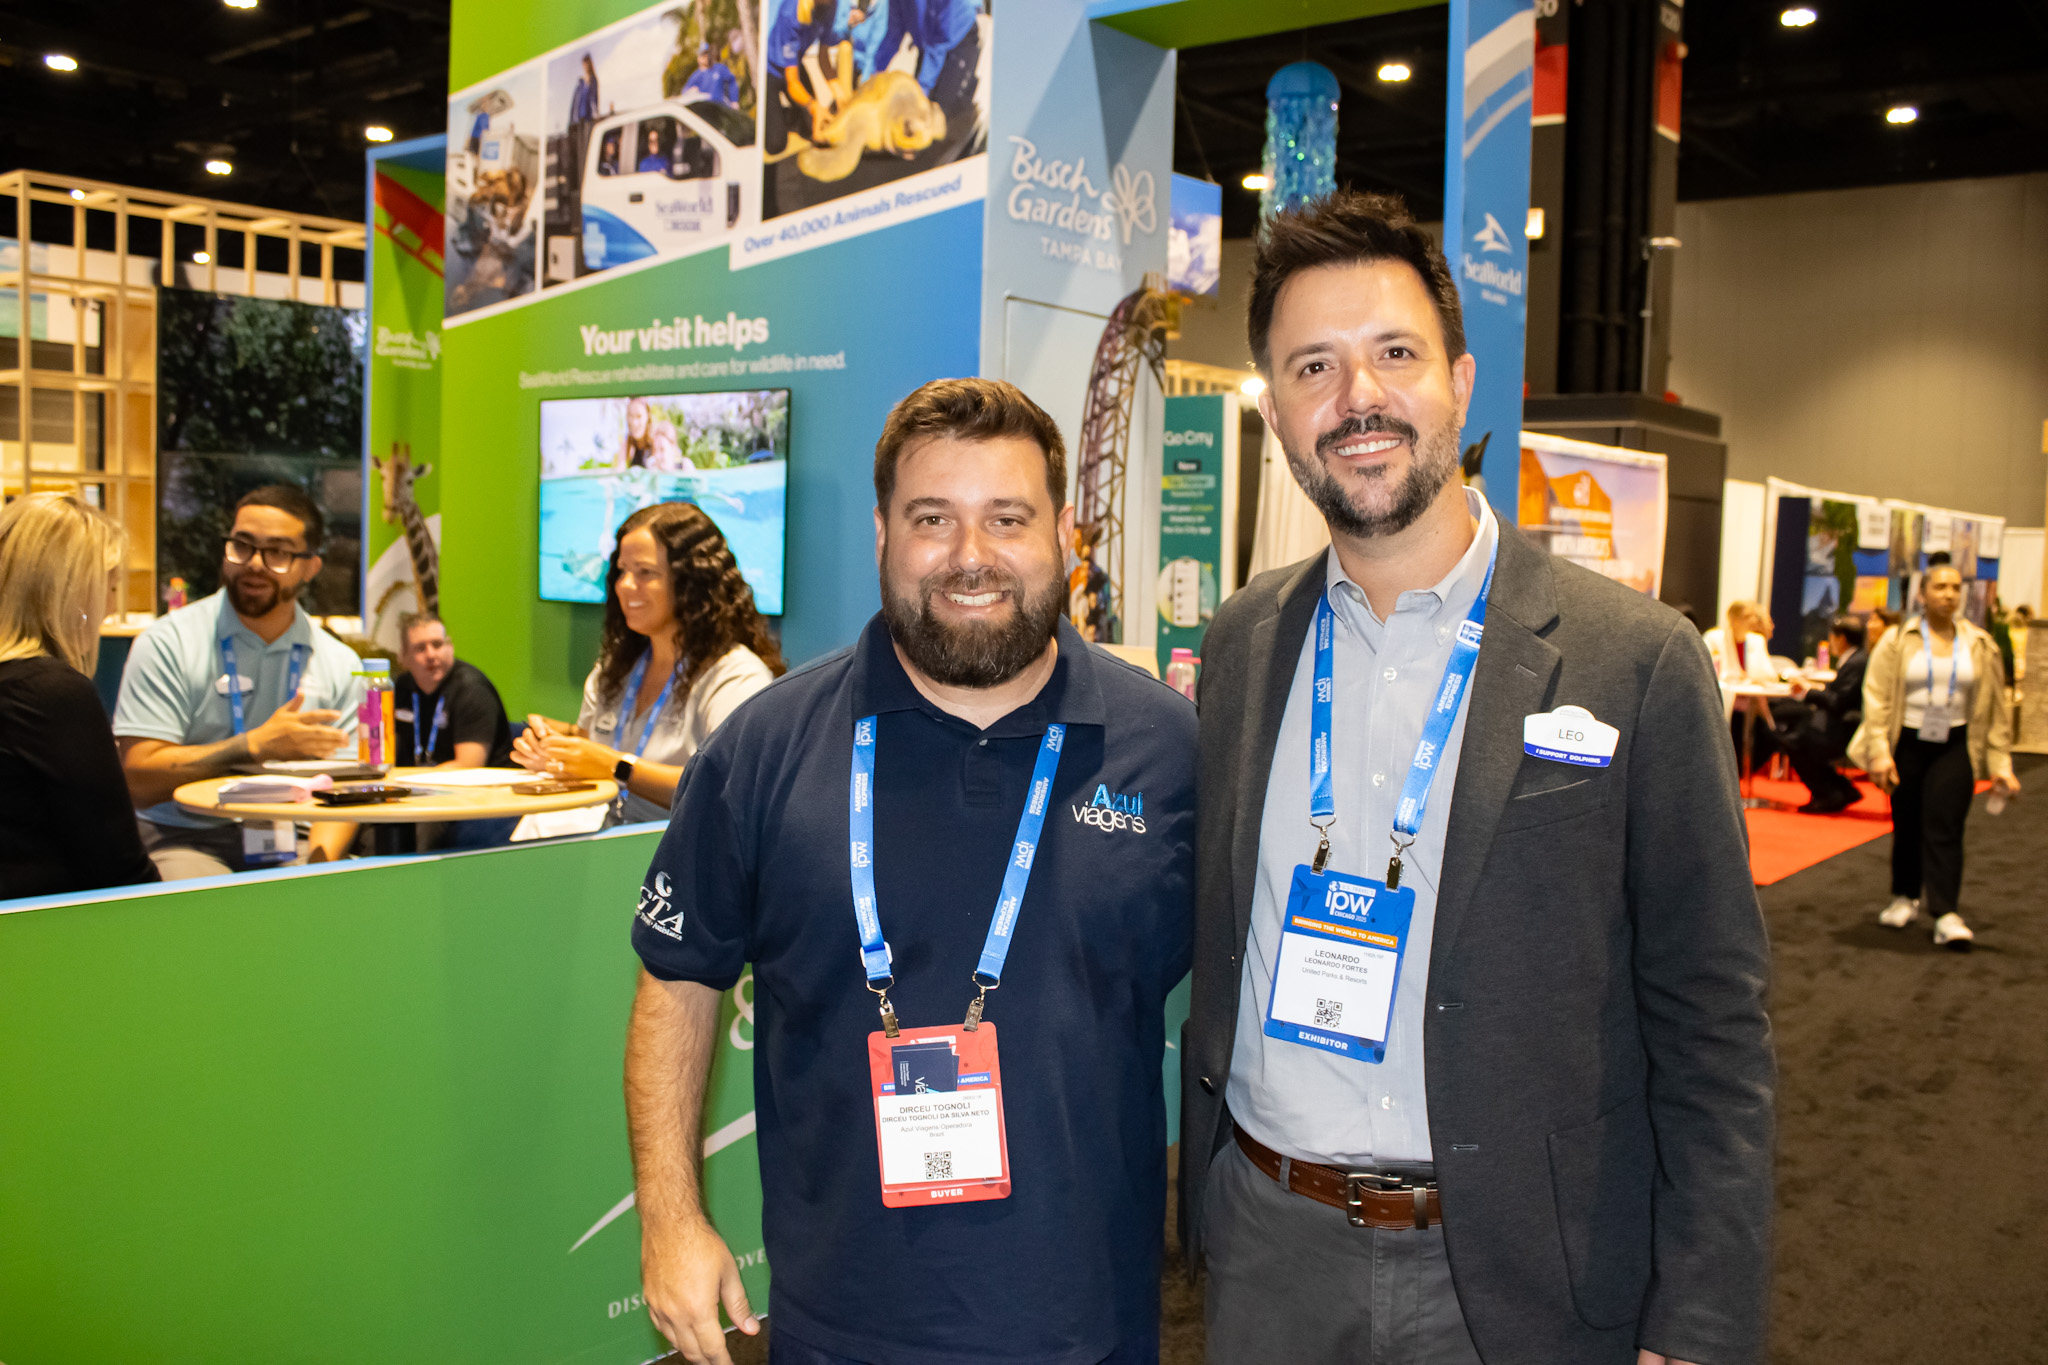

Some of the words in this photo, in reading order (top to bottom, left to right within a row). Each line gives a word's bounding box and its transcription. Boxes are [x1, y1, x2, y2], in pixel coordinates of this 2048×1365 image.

[1008, 134, 1099, 198] Busch
[744, 236, 774, 253] Over
[780, 215, 831, 242] 40,000
[833, 199, 891, 226] Animals
[895, 176, 962, 208] Rescued
[1008, 181, 1113, 240] Gardens
[1464, 253, 1522, 295] SeaWorld
[580, 324, 636, 356] Your
[638, 316, 692, 351] visit
[694, 311, 769, 352] helps
[1436, 672, 1457, 714] AMERICAN
[1445, 674, 1463, 710] EXPRESS
[1320, 731, 1328, 773] AMERICAN
[1558, 728, 1585, 742] LEO
[1539, 749, 1568, 760] SUPPORT
[1569, 754, 1601, 764] DOLPHINS
[854, 773, 862, 813] AMERICAN
[861, 772, 869, 807] EXPRESS
[1028, 780, 1043, 815] EXPRESS
[1035, 776, 1049, 816] AMERICAN
[1091, 783, 1143, 816] Azul
[1072, 800, 1147, 834] viagens
[858, 898, 872, 940] AMERICAN
[994, 900, 1009, 936] EXPRESS
[1001, 896, 1018, 937] AMERICAN
[1325, 889, 1375, 916] ipw
[1334, 910, 1356, 921] CHICAGO
[1355, 914, 1367, 923] 2025
[1294, 917, 1322, 930] BRINGING
[1323, 925, 1335, 933] THE
[1335, 927, 1358, 938] WORLD
[1358, 932, 1367, 940] TO
[1367, 935, 1395, 946] AMERICA
[1304, 957, 1341, 969] LEONARDO
[1341, 963, 1368, 974] FORTES
[1315, 949, 1360, 964] LEONARDO
[1302, 967, 1321, 976] United
[1321, 971, 1338, 980] Parks
[1345, 975, 1368, 985] Resorts
[1298, 1031, 1348, 1051] EXHIBITOR
[960, 1075, 989, 1084] AMERICA
[882, 1115, 907, 1123] DIRCEU
[909, 1113, 939, 1121] TOGNOLI
[971, 1109, 990, 1117] NETO
[899, 1105, 931, 1114] DIRCEU
[933, 1102, 971, 1112] TOGNOLI
[900, 1124, 914, 1132] Azul
[916, 1124, 939, 1132] Viagens
[940, 1122, 973, 1130] Operadora
[930, 1188, 964, 1198] BUYER
